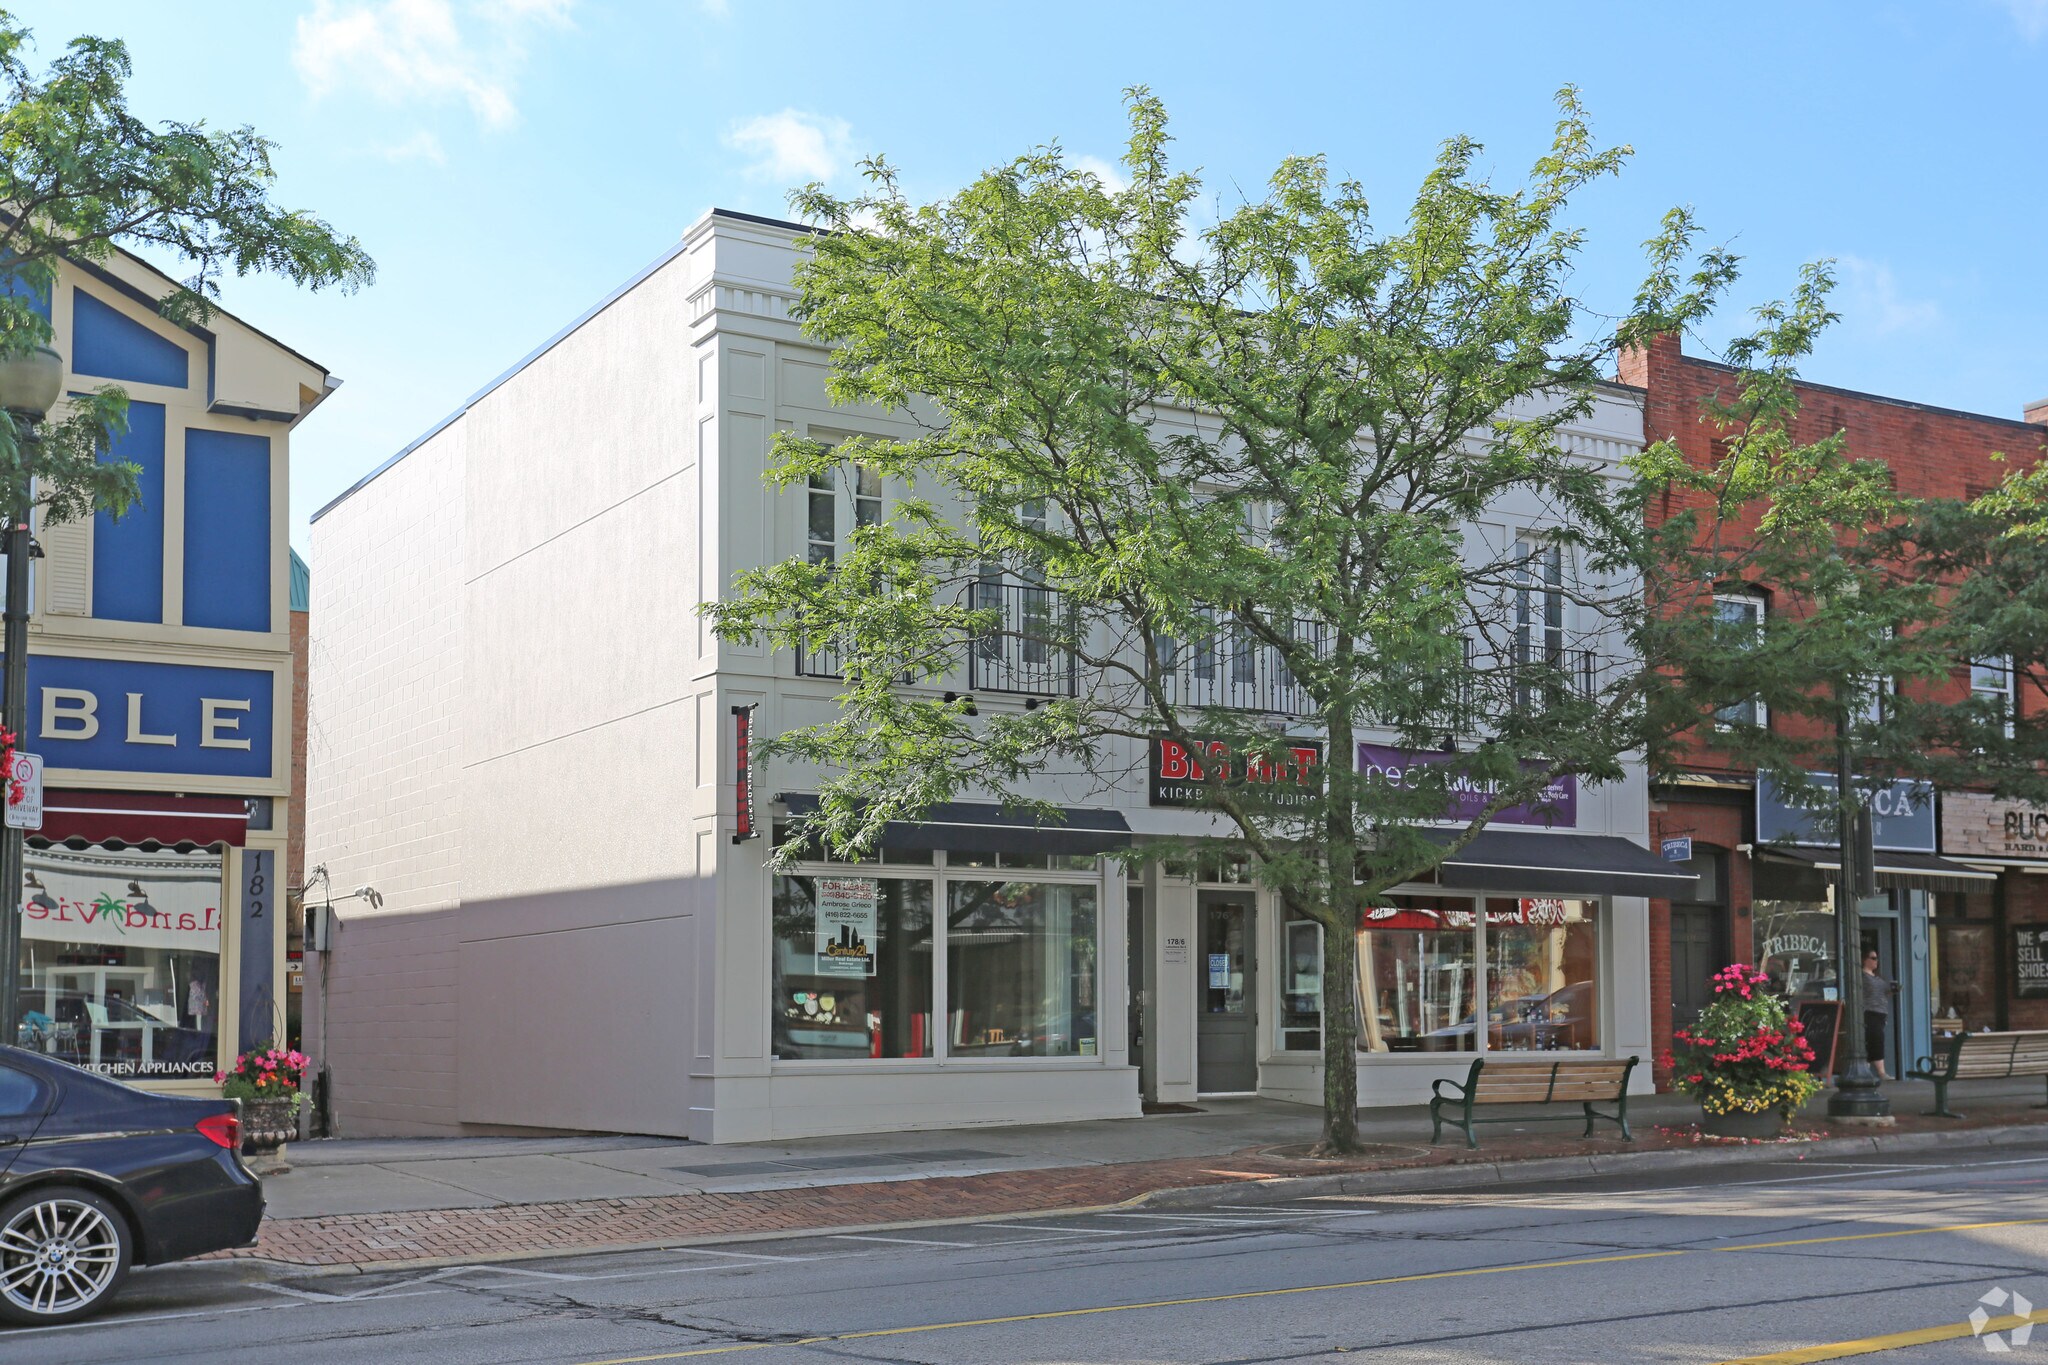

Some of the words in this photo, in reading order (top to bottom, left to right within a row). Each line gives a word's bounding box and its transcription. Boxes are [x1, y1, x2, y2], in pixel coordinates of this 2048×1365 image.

[39, 686, 251, 751] BLE
[1459, 793, 1478, 802] OILS
[822, 881, 840, 890] FOR
[2017, 931, 2034, 946] WE
[1762, 934, 1829, 960] TRIBECA
[2018, 947, 2044, 962] SELL
[77, 1062, 136, 1074] KITCHEN
[137, 1061, 214, 1074] APPLIANCES
